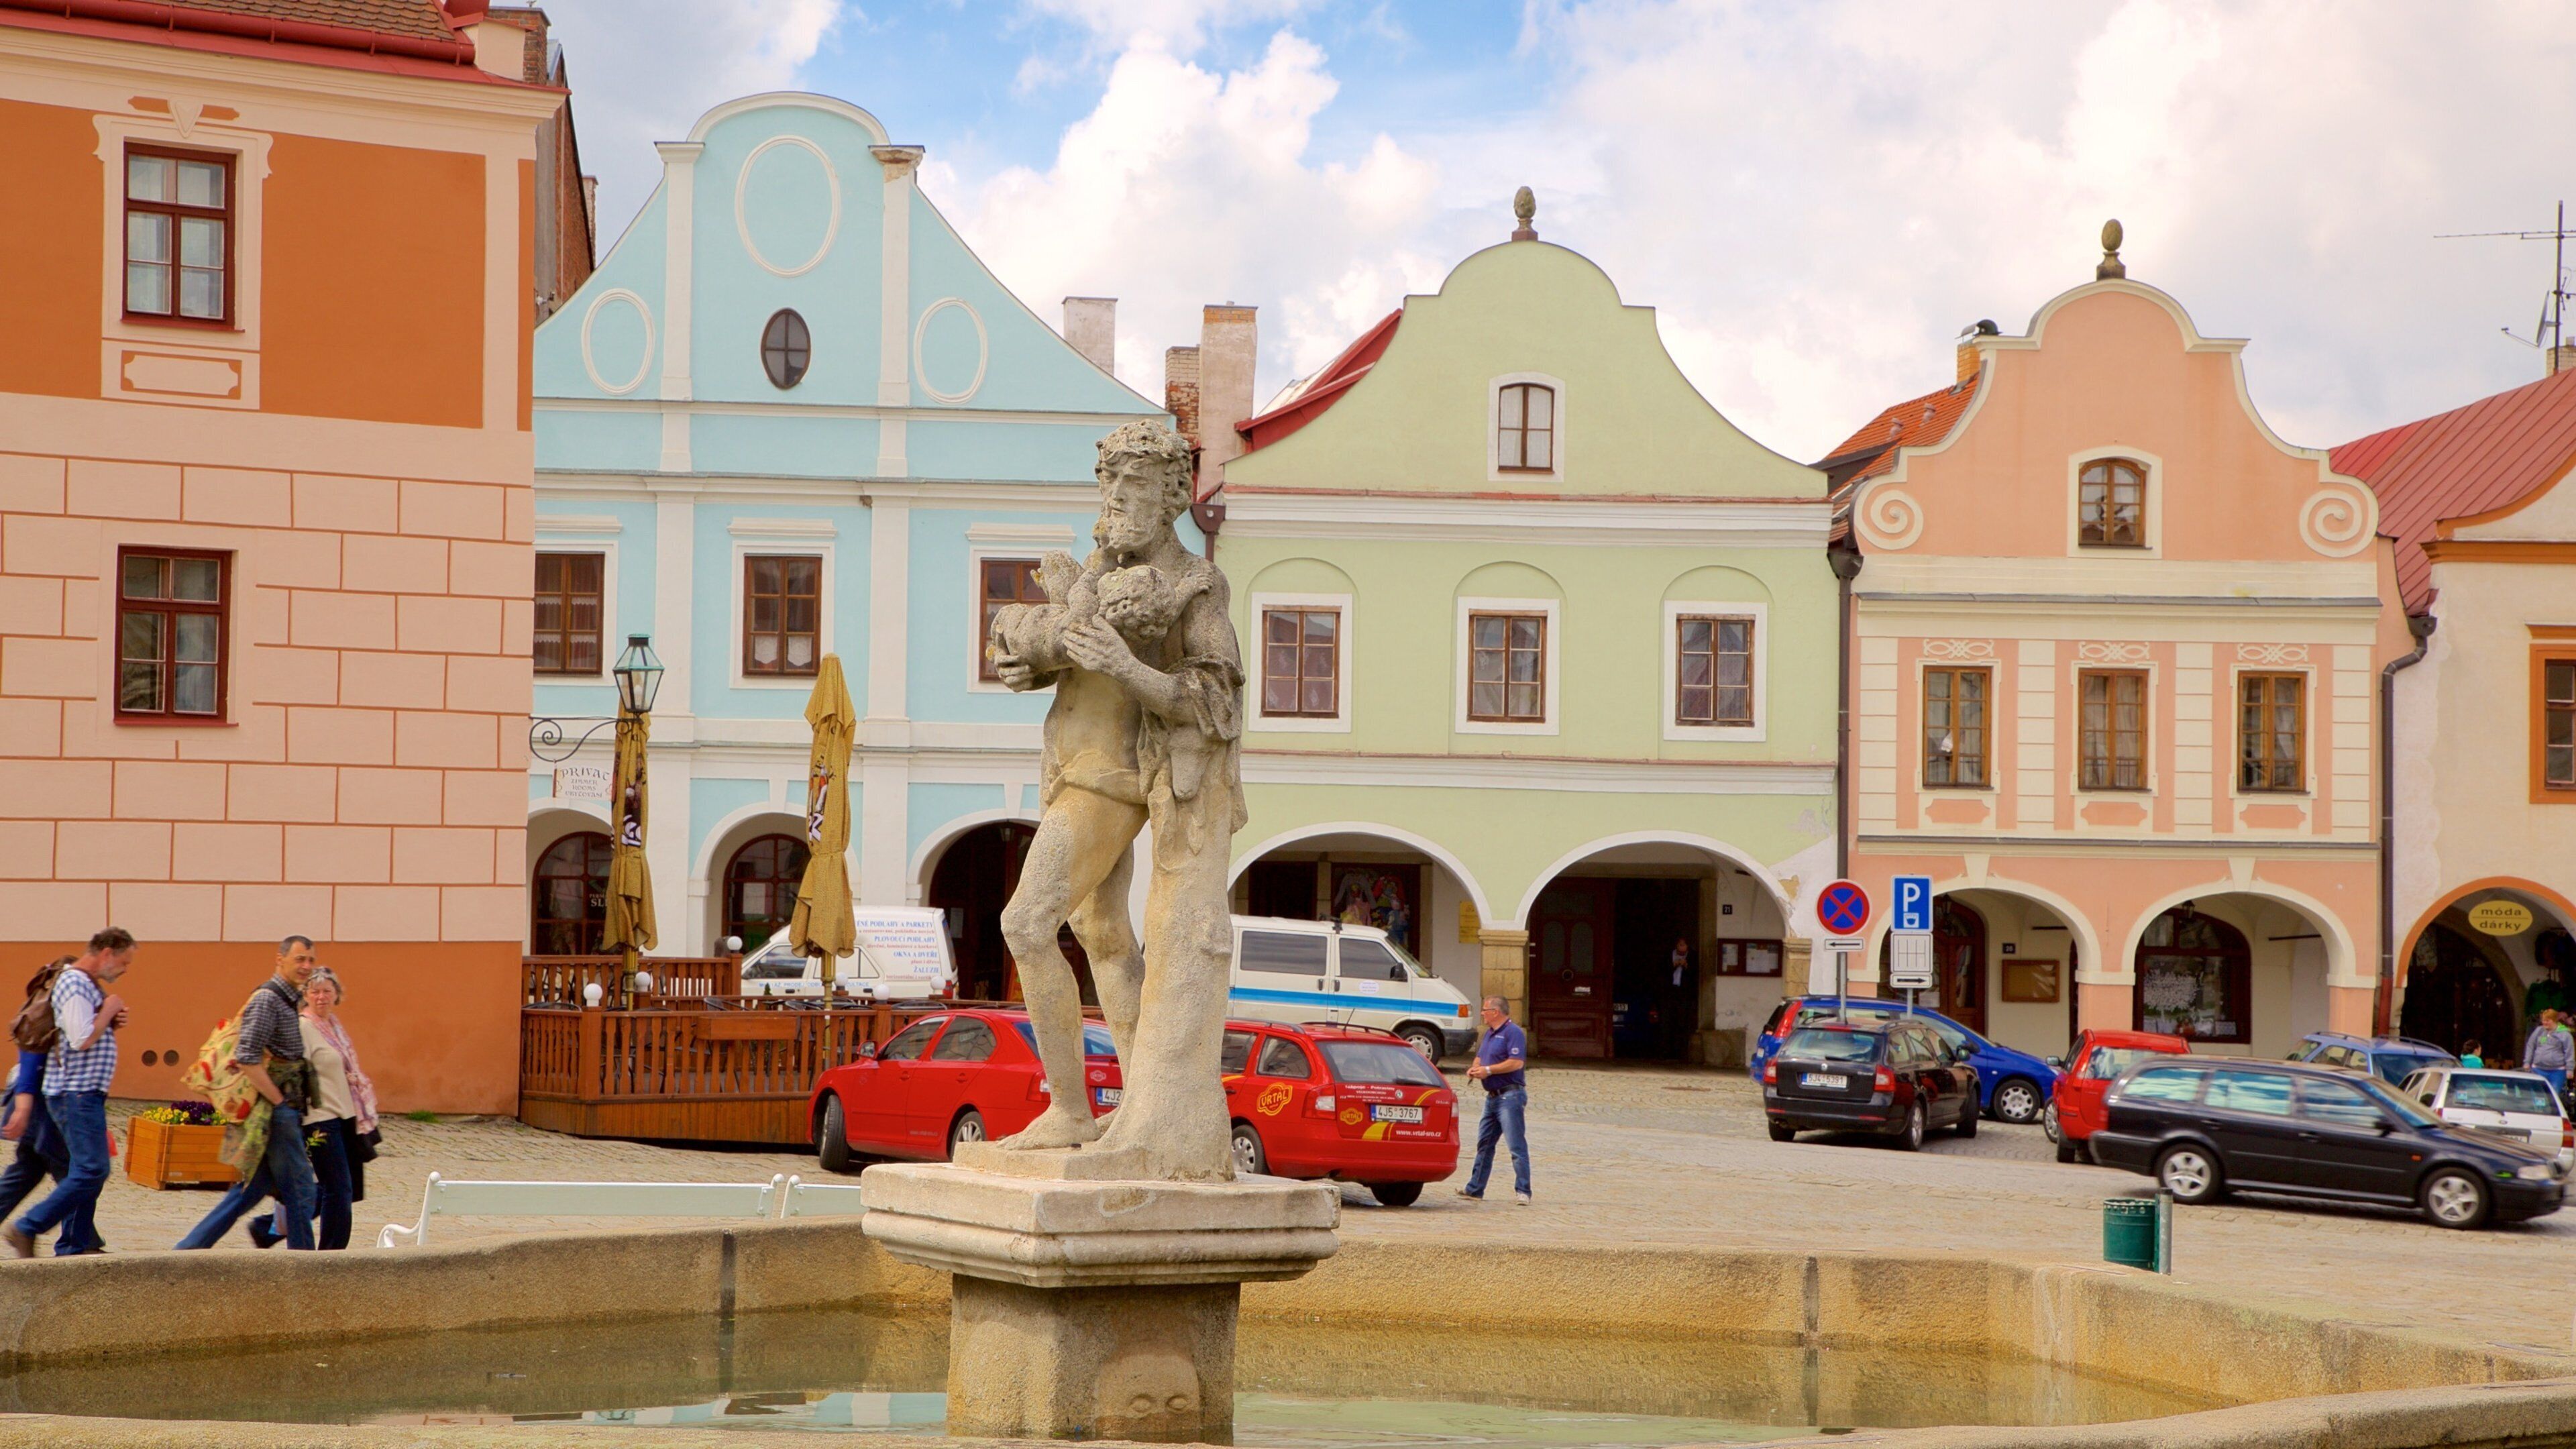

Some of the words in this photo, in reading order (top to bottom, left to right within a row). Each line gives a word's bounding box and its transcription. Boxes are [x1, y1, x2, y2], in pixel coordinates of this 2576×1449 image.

[1903, 883, 1921, 912] P
[2481, 907, 2522, 916] móda
[2479, 920, 2521, 931] dárky
[1105, 1090, 1121, 1101] 4J2
[1378, 1107, 1393, 1117] 4J5
[1399, 1108, 1419, 1118] 3767
